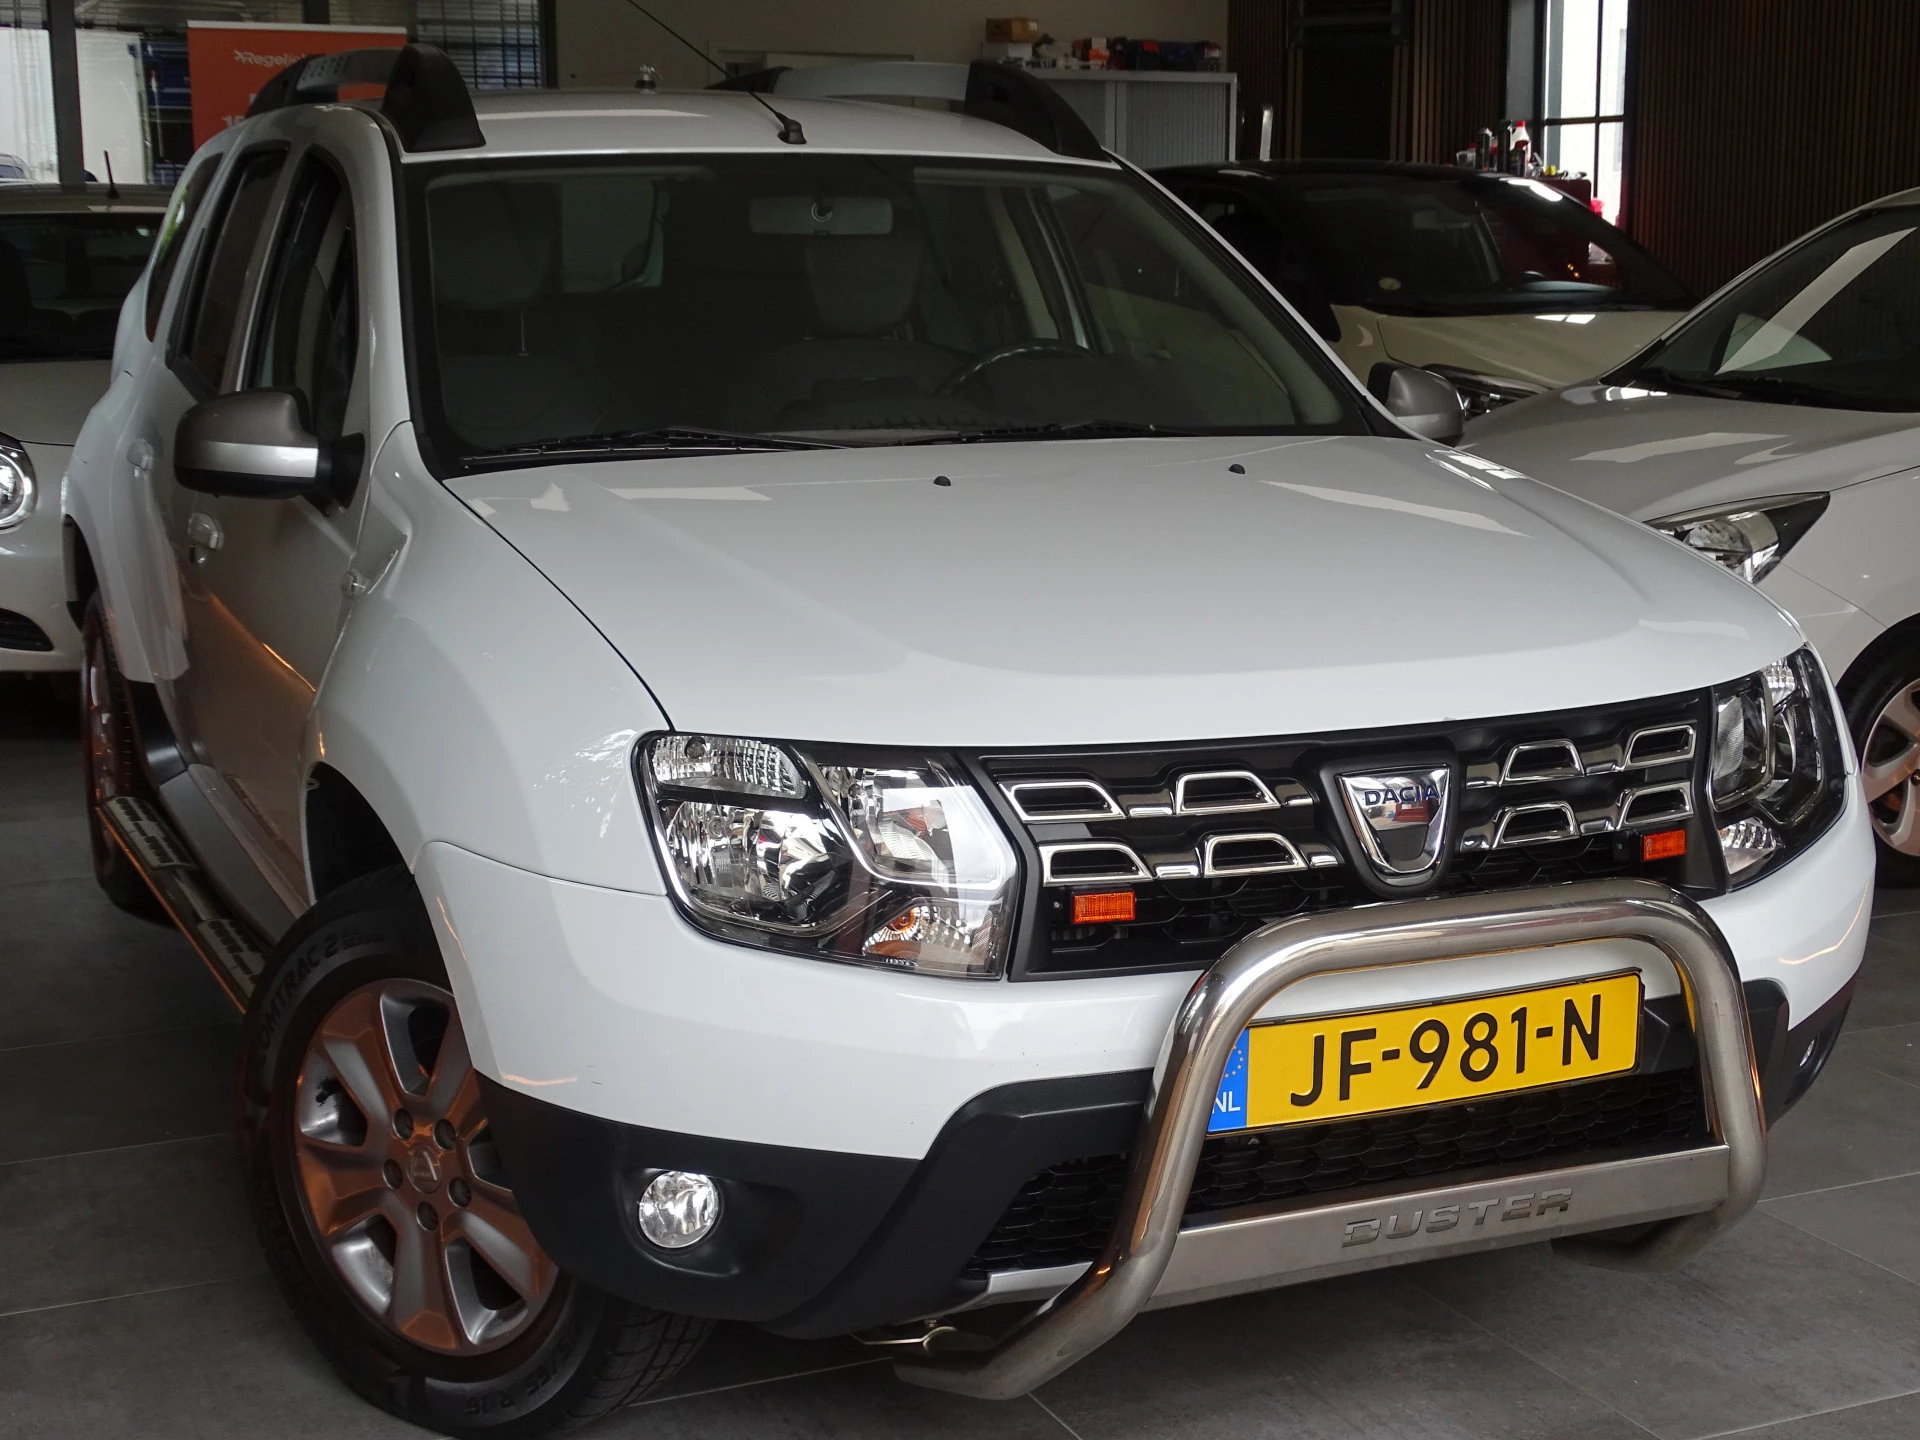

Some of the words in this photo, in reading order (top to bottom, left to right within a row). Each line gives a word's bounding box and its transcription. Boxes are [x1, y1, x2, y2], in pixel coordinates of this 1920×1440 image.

[1364, 784, 1440, 806] DACIA
[1290, 994, 1602, 1107] JF-981-N
[1213, 1091, 1241, 1114] NL
[1342, 1188, 1573, 1248] DUSTER
